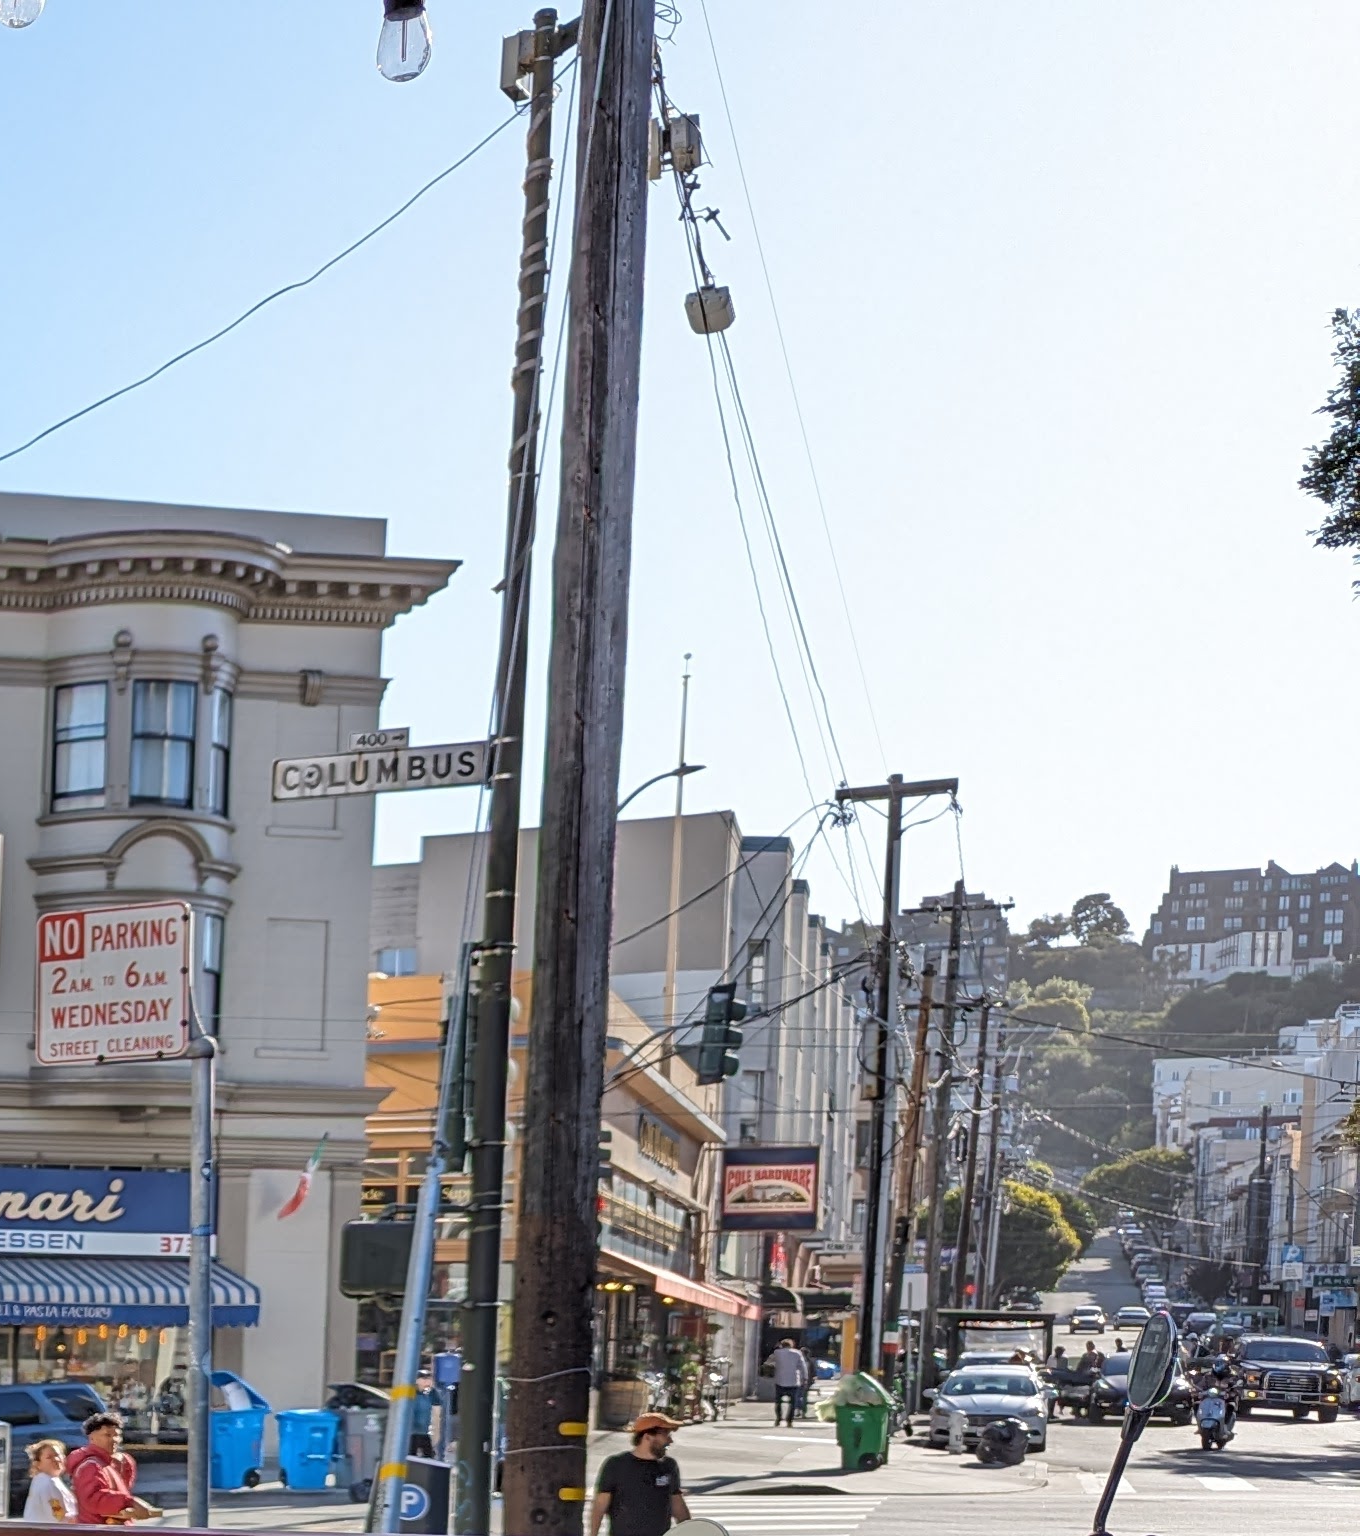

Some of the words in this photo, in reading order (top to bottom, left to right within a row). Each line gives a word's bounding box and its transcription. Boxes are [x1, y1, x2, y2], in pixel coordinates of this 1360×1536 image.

[356, 733, 387, 746] 400
[282, 751, 475, 791] COLUMBUS
[44, 918, 80, 957] NO
[91, 917, 177, 952] PARKING
[51, 997, 173, 1029] WEDNESDAY
[50, 1040, 98, 1057] STREET
[107, 1035, 173, 1053] CLEANING
[728, 1170, 752, 1195] COLE
[754, 1169, 811, 1195] HARDWARE
[23, 1305, 59, 1318] PASTA
[61, 1306, 111, 1319] FACTORY
